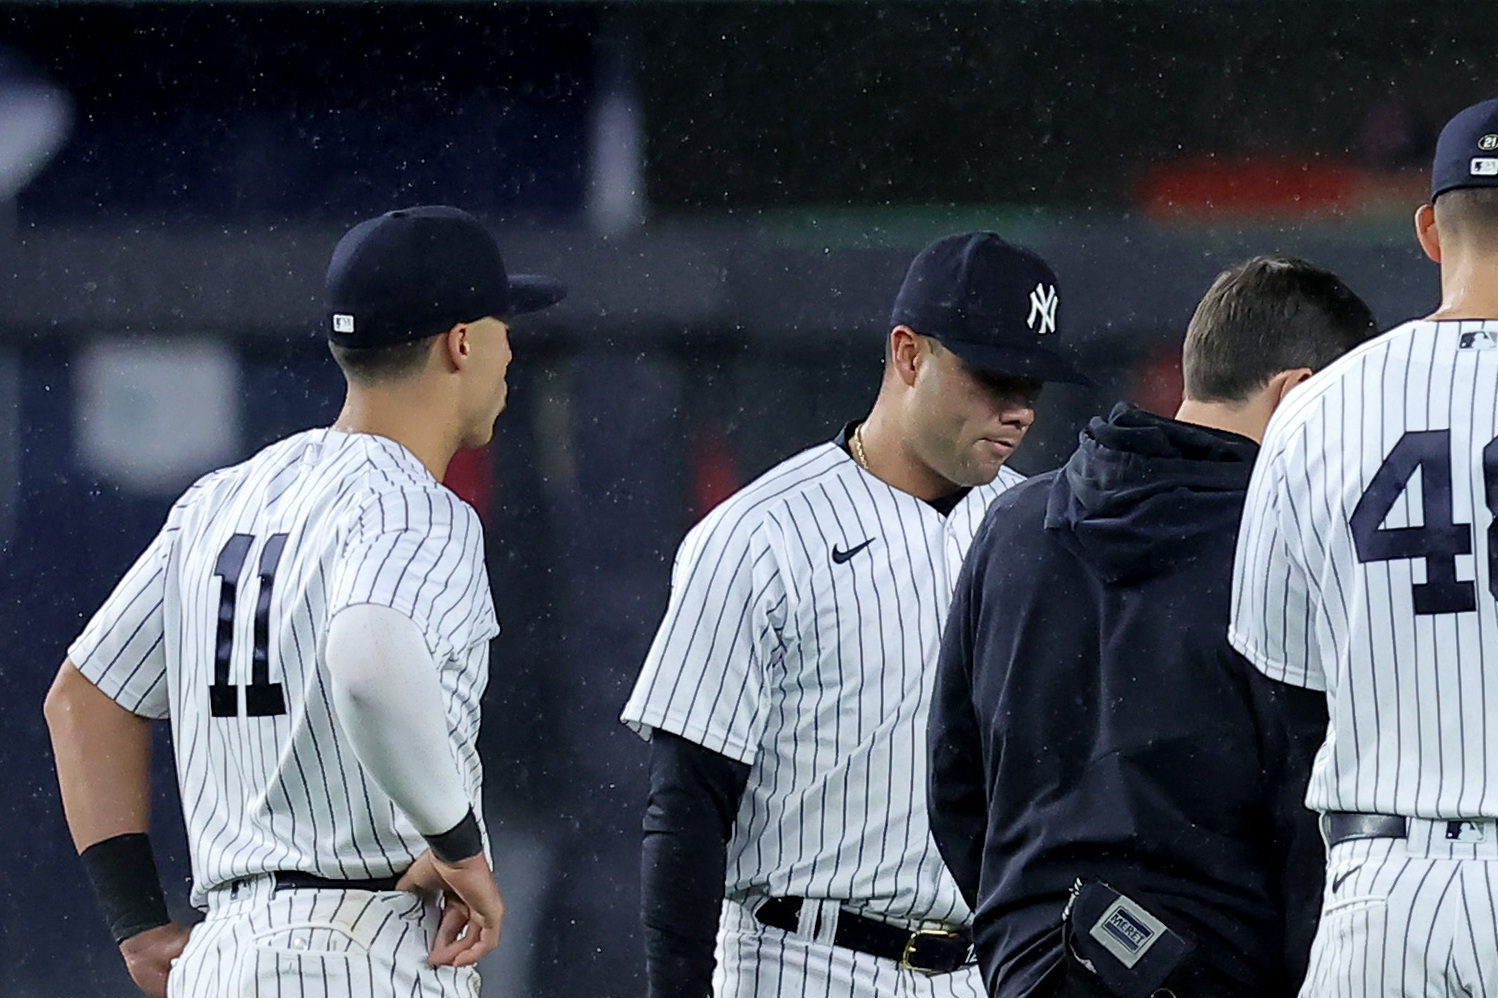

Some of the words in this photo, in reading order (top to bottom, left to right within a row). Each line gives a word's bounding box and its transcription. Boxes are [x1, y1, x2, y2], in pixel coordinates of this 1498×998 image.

[1483, 136, 1498, 148] 21
[1026, 282, 1059, 334] NY
[208, 532, 288, 718] 11
[1110, 913, 1146, 945] MERET
